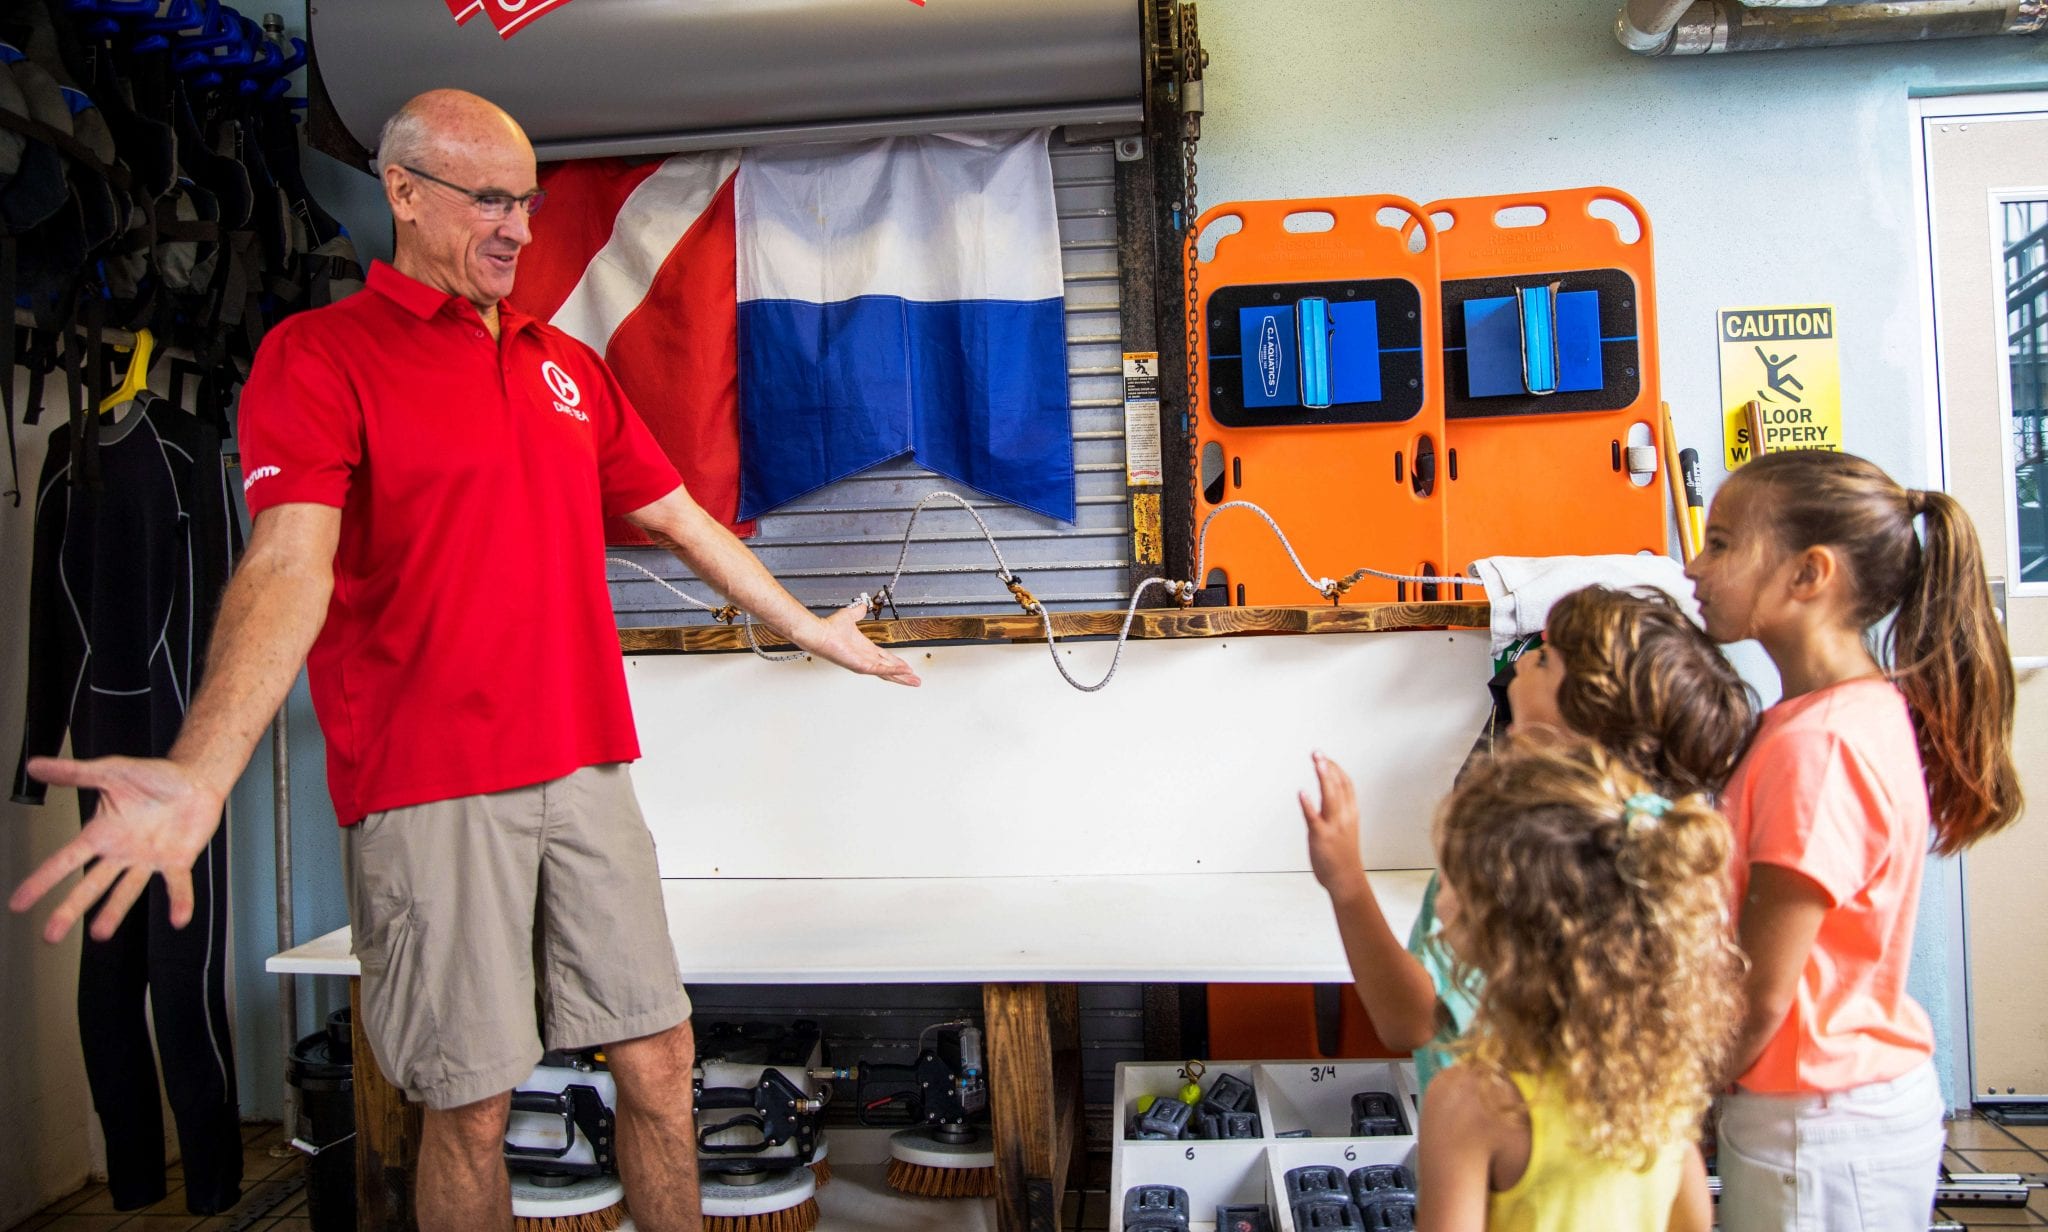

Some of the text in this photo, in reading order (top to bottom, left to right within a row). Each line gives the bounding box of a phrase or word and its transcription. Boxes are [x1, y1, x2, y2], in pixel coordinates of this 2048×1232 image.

[1726, 312, 1829, 338] CAUTION
[1268, 341, 1276, 386] AQUATICS
[1762, 408, 1813, 424] LOOR
[1737, 426, 1829, 444] SPPERY
[1310, 1065, 1336, 1082] 3/4
[1185, 1147, 1195, 1160] 6
[1344, 1144, 1357, 1161] 6
